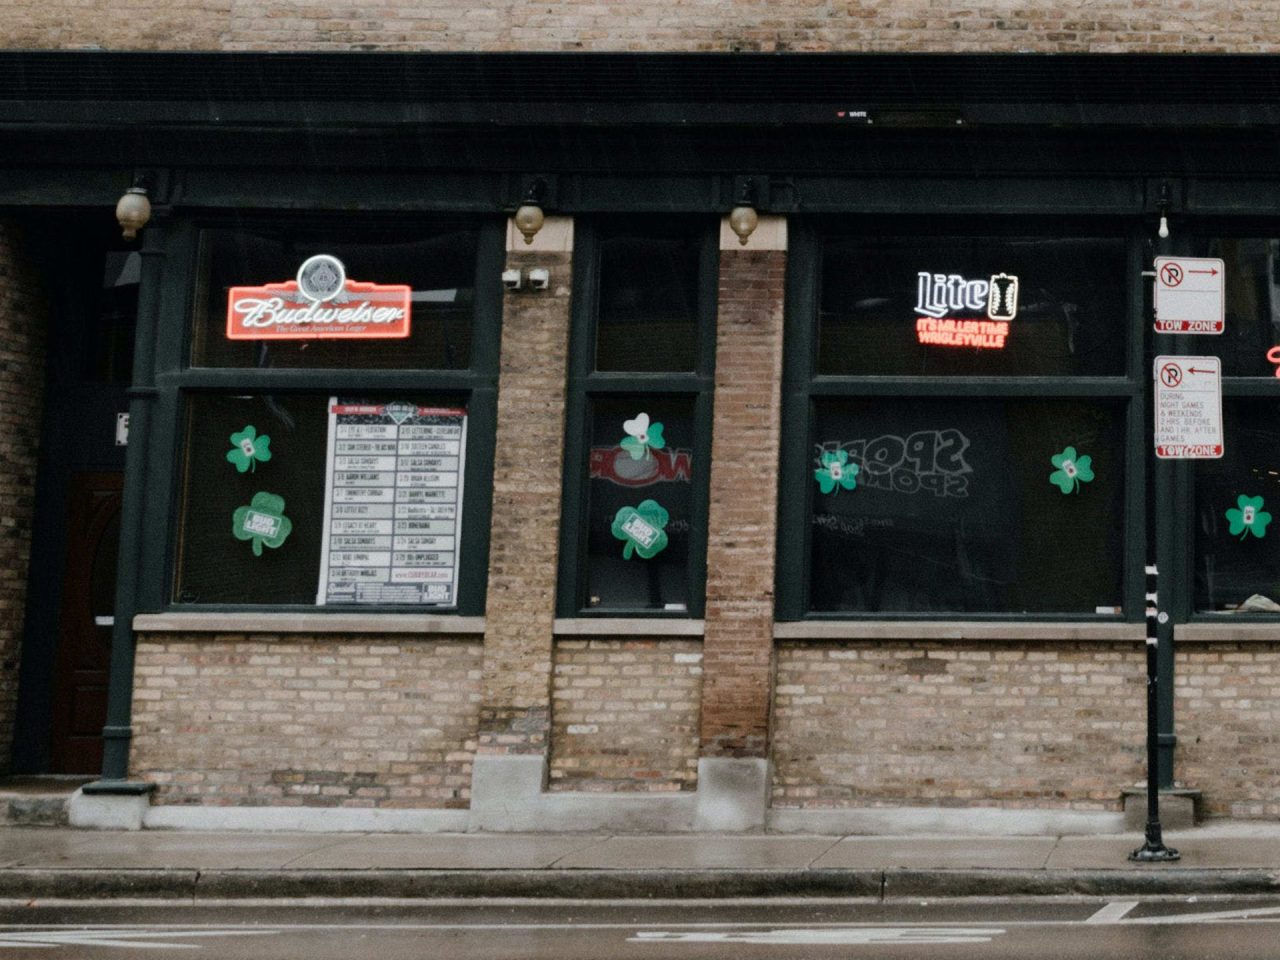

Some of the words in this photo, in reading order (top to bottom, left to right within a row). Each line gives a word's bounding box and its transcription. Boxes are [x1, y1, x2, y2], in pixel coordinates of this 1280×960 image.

[914, 272, 989, 318] Lite
[234, 297, 406, 328] Budweiser
[939, 319, 979, 334] MILLER
[980, 321, 1009, 336] TIME
[1160, 321, 1183, 331] TOW
[1188, 321, 1217, 332] ZONE
[918, 331, 1005, 348] WRIGLEYVILLE
[1189, 445, 1216, 456] ZONE
[244, 520, 277, 536] LIGHT
[253, 514, 274, 527] BUD
